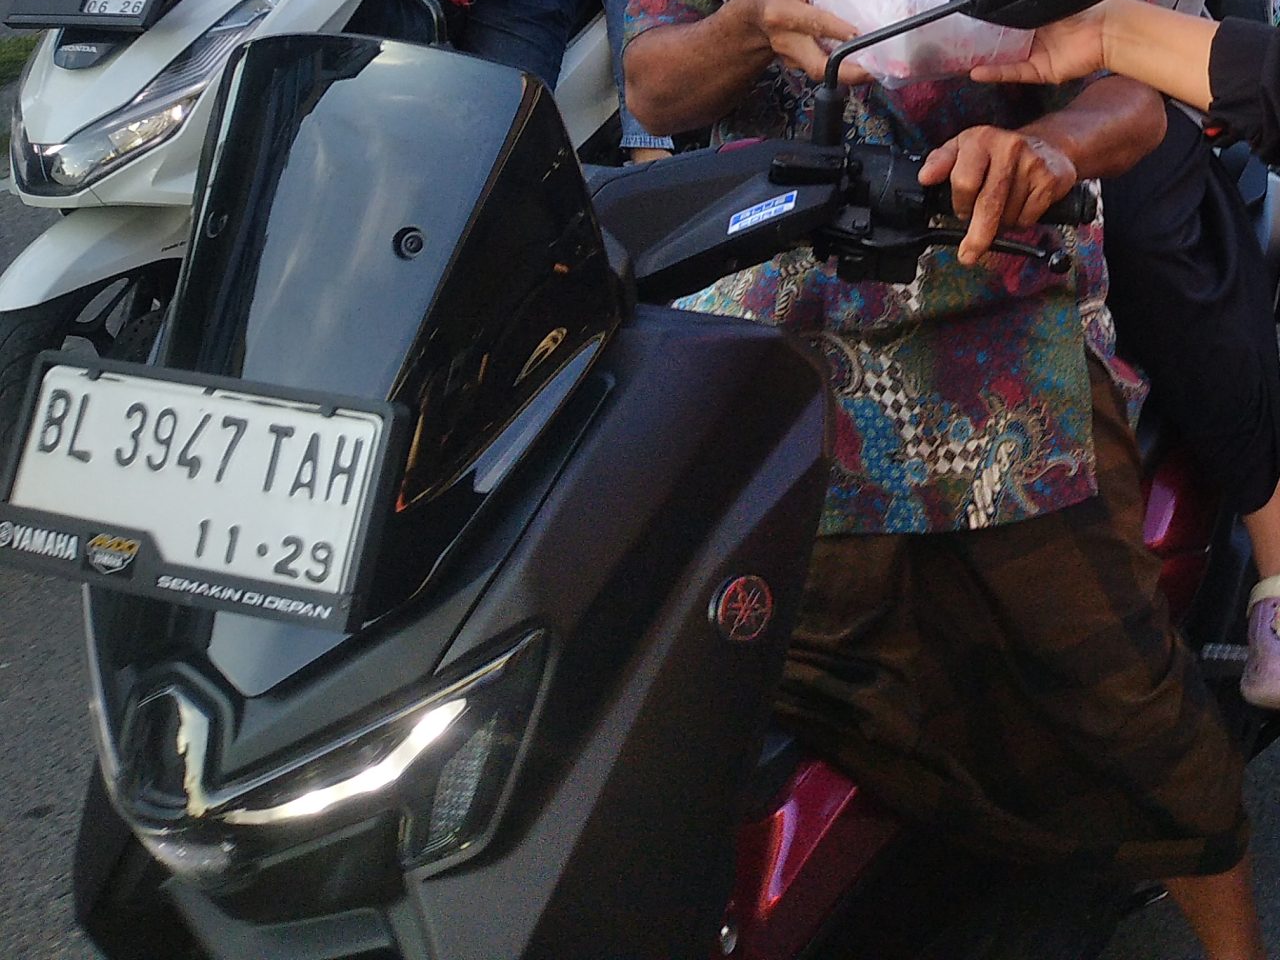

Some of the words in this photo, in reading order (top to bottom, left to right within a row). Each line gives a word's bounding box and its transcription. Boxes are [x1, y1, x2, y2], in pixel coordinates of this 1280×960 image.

[87, 0, 108, 14] 06
[120, 0, 143, 13] 26
[60, 45, 97, 53] HONDA
[38, 389, 92, 463] BL
[115, 402, 248, 483] 3947
[262, 423, 365, 506] TAH
[12, 524, 78, 561] YAMAHA
[156, 575, 243, 602] SEMAKIN
[242, 591, 264, 606] DI
[262, 596, 333, 620] DEPAN
